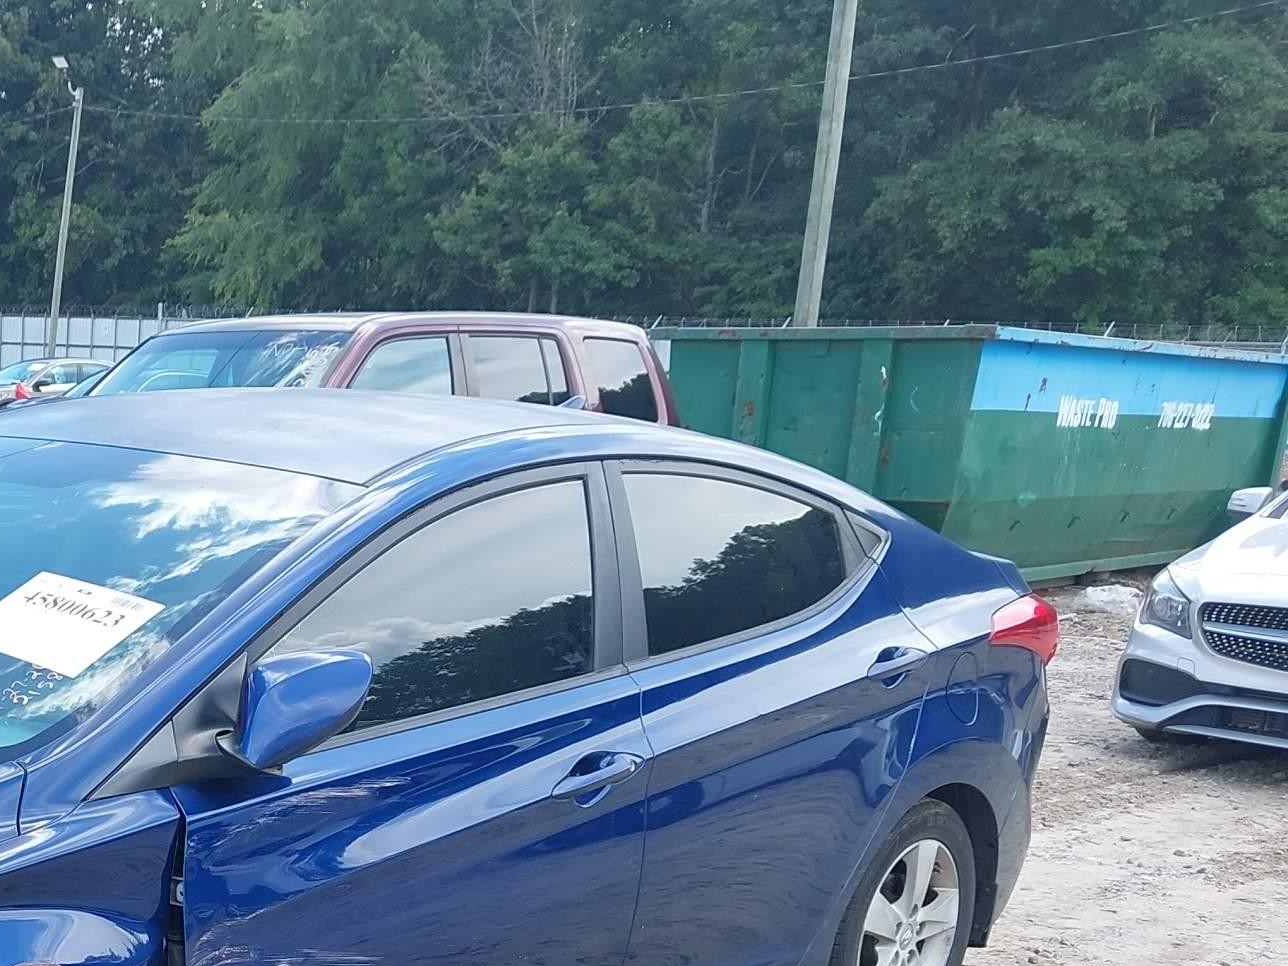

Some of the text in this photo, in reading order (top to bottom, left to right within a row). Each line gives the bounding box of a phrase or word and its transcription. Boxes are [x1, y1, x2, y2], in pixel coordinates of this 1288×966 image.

[1056, 394, 1096, 428] WASTE
[1094, 397, 1120, 430] PRO
[24, 590, 126, 627] 45800623
